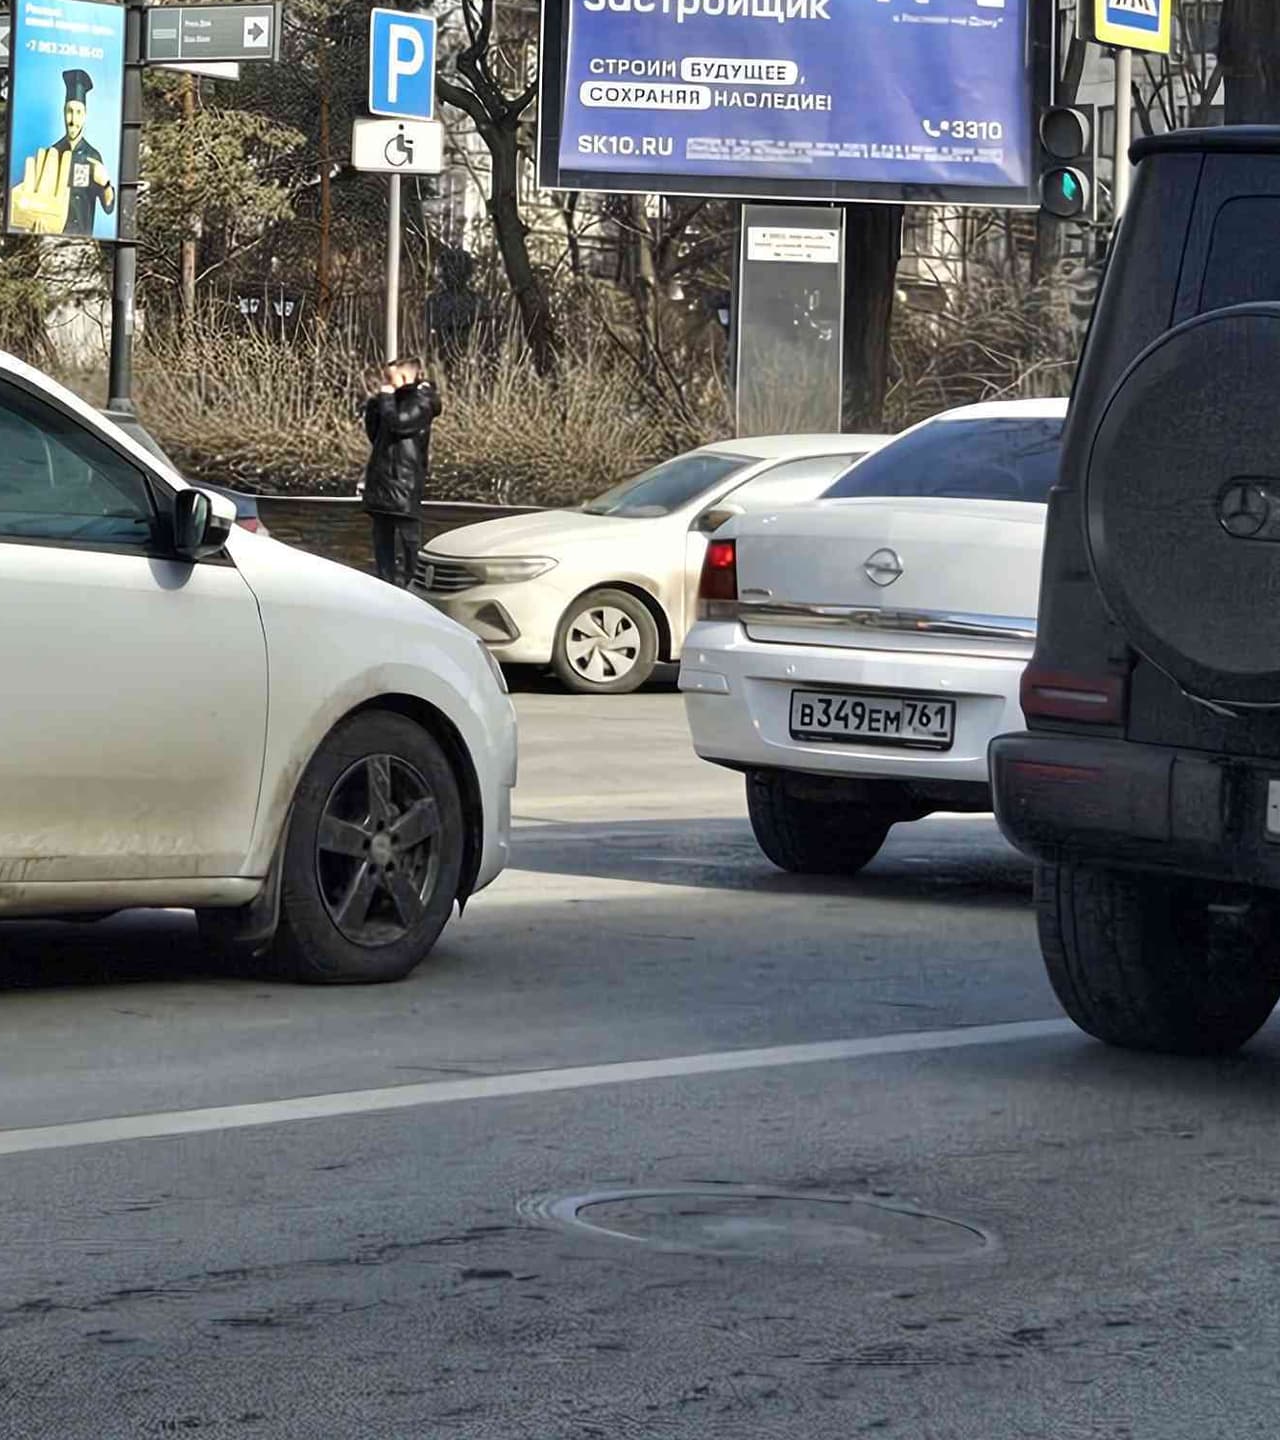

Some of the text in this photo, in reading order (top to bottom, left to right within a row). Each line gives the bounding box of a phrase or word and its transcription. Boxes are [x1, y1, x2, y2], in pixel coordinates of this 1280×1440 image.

[388, 24, 424, 103] P
[589, 58, 676, 77] СТРОИМ
[589, 86, 701, 105] СОХРАНЯЯ
[951, 120, 1003, 140] 3310
[577, 134, 673, 156] SK10.RU
